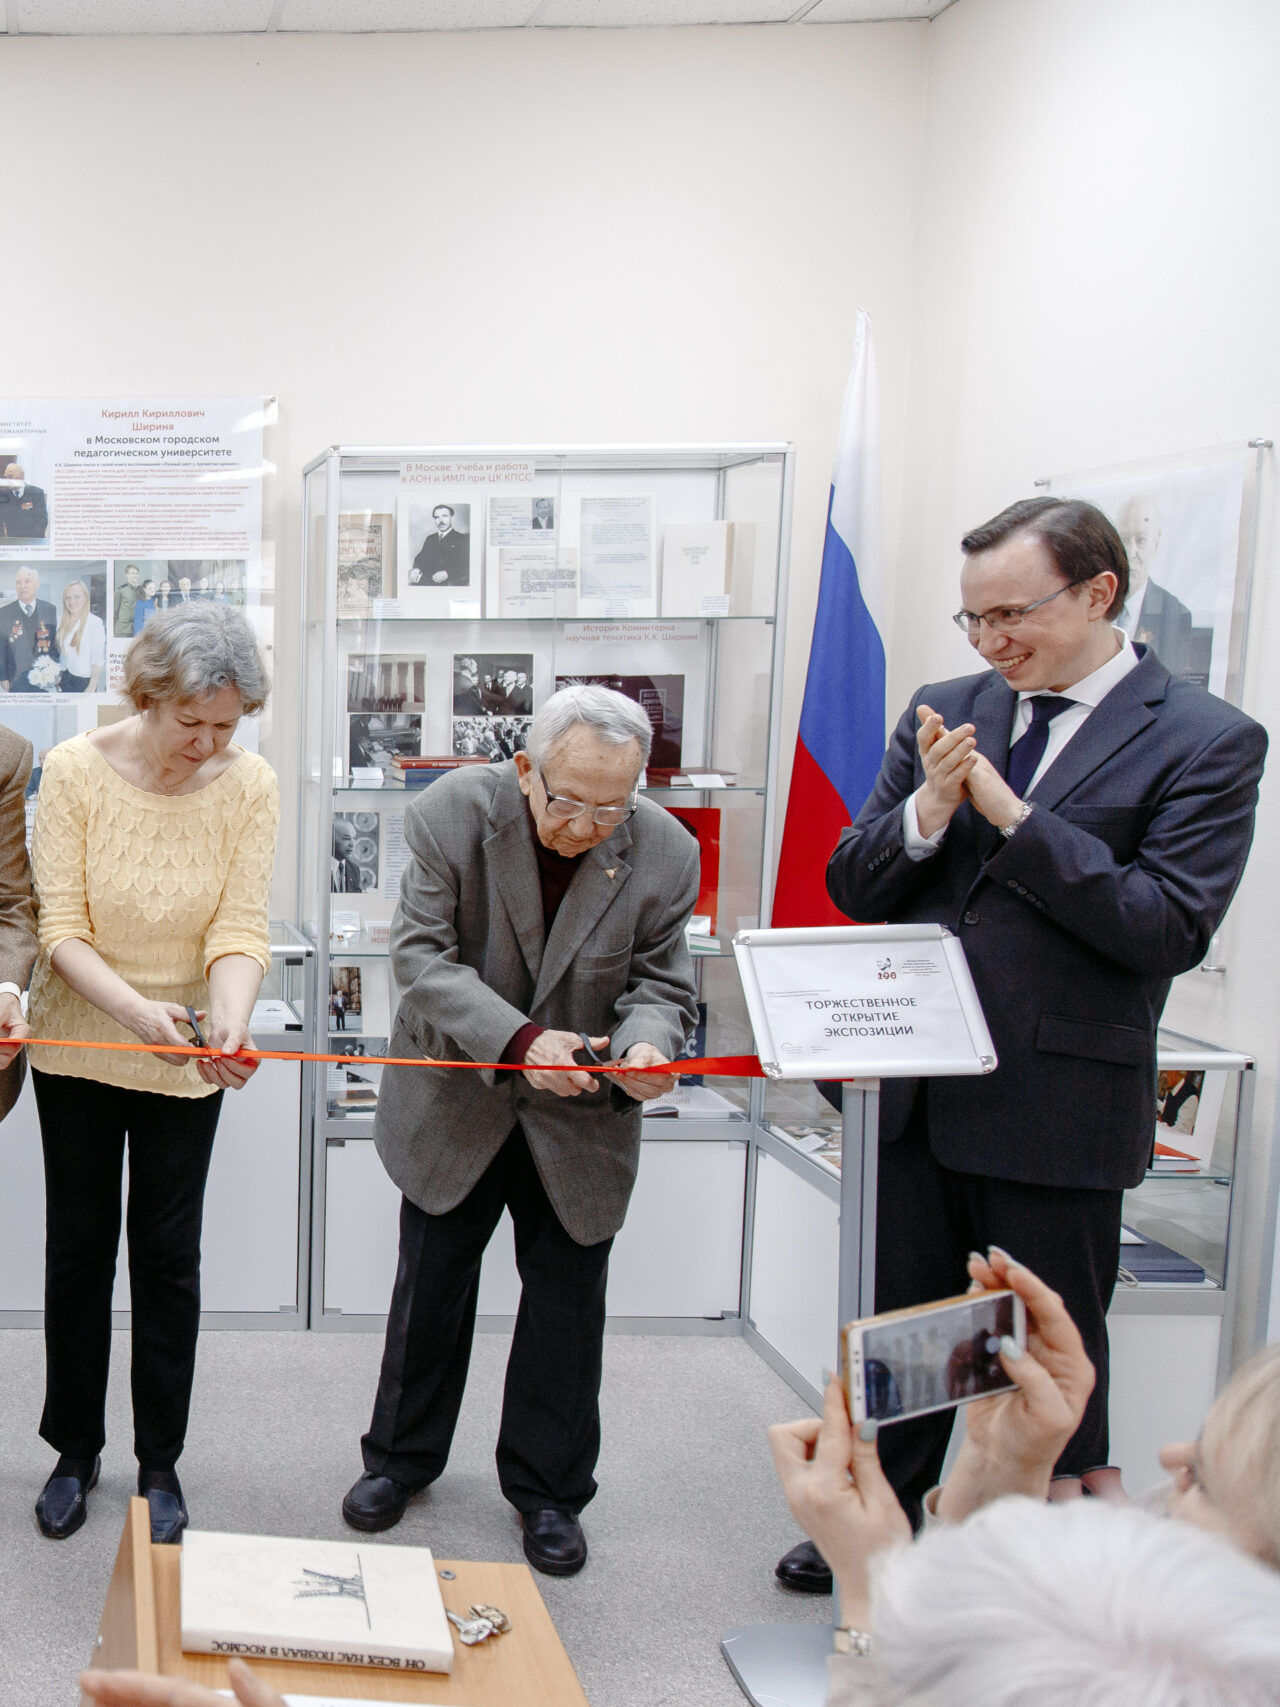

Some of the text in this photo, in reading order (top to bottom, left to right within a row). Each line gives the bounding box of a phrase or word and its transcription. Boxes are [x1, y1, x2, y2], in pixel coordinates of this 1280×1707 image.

[101, 409, 205, 420] Кирилл Кириллович
[132, 423, 174, 432] Шириня
[95, 436, 160, 444] Московском
[163, 436, 220, 445] городском
[74, 449, 232, 458] педагогическом университете
[406, 464, 412, 472] В
[495, 463, 528, 472] работа
[410, 475, 431, 483] АОН
[443, 474, 465, 482] ИМЛ
[468, 475, 486, 483] при
[488, 474, 501, 482] ЦК
[504, 473, 532, 481] КПСС
[583, 624, 619, 632] История
[622, 624, 675, 632] Коминтерна
[566, 634, 600, 643] научная
[662, 633, 698, 642] Ширини
[372, 927, 391, 936] Геор
[806, 997, 918, 1010] ТОРЖЕСТВЕННОЕ
[832, 1012, 900, 1023] ОТКРЫТИЕ
[824, 1025, 914, 1038] ЭКСПОЗИЦИИ
[212, 1640, 425, 1670] ОН ВСЕХ НАС ПОЗВАЛ В КОСМОС
